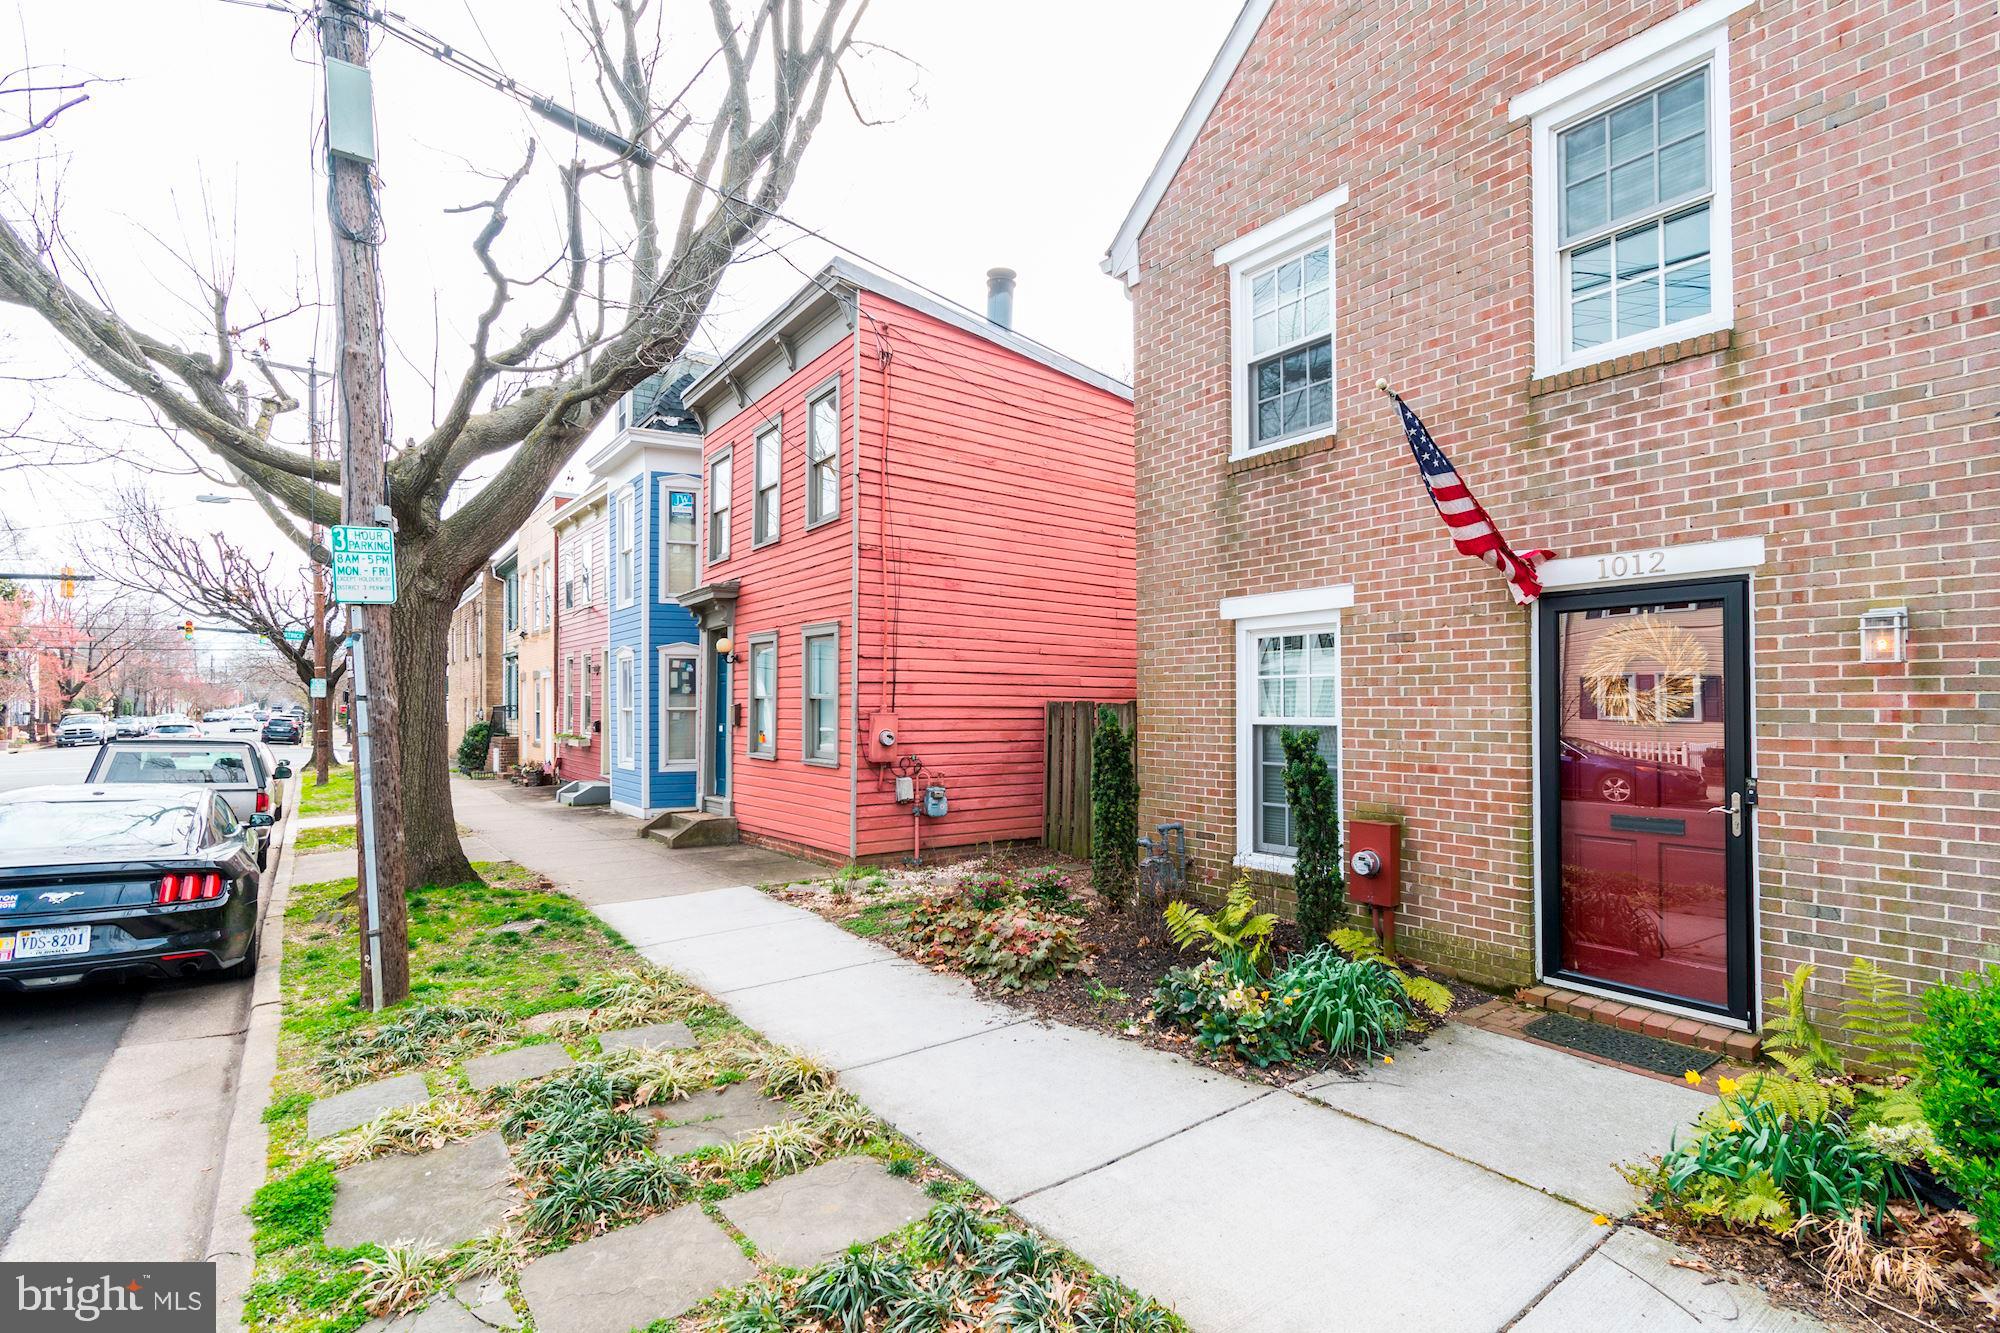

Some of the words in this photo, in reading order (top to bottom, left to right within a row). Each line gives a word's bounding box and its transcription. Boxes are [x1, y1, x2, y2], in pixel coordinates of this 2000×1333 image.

[333, 527, 346, 551] 3
[354, 531, 383, 540] HOUR
[349, 541, 390, 551] PARKING
[1598, 551, 1666, 579] 1012
[22, 933, 84, 950] VDS-8201
